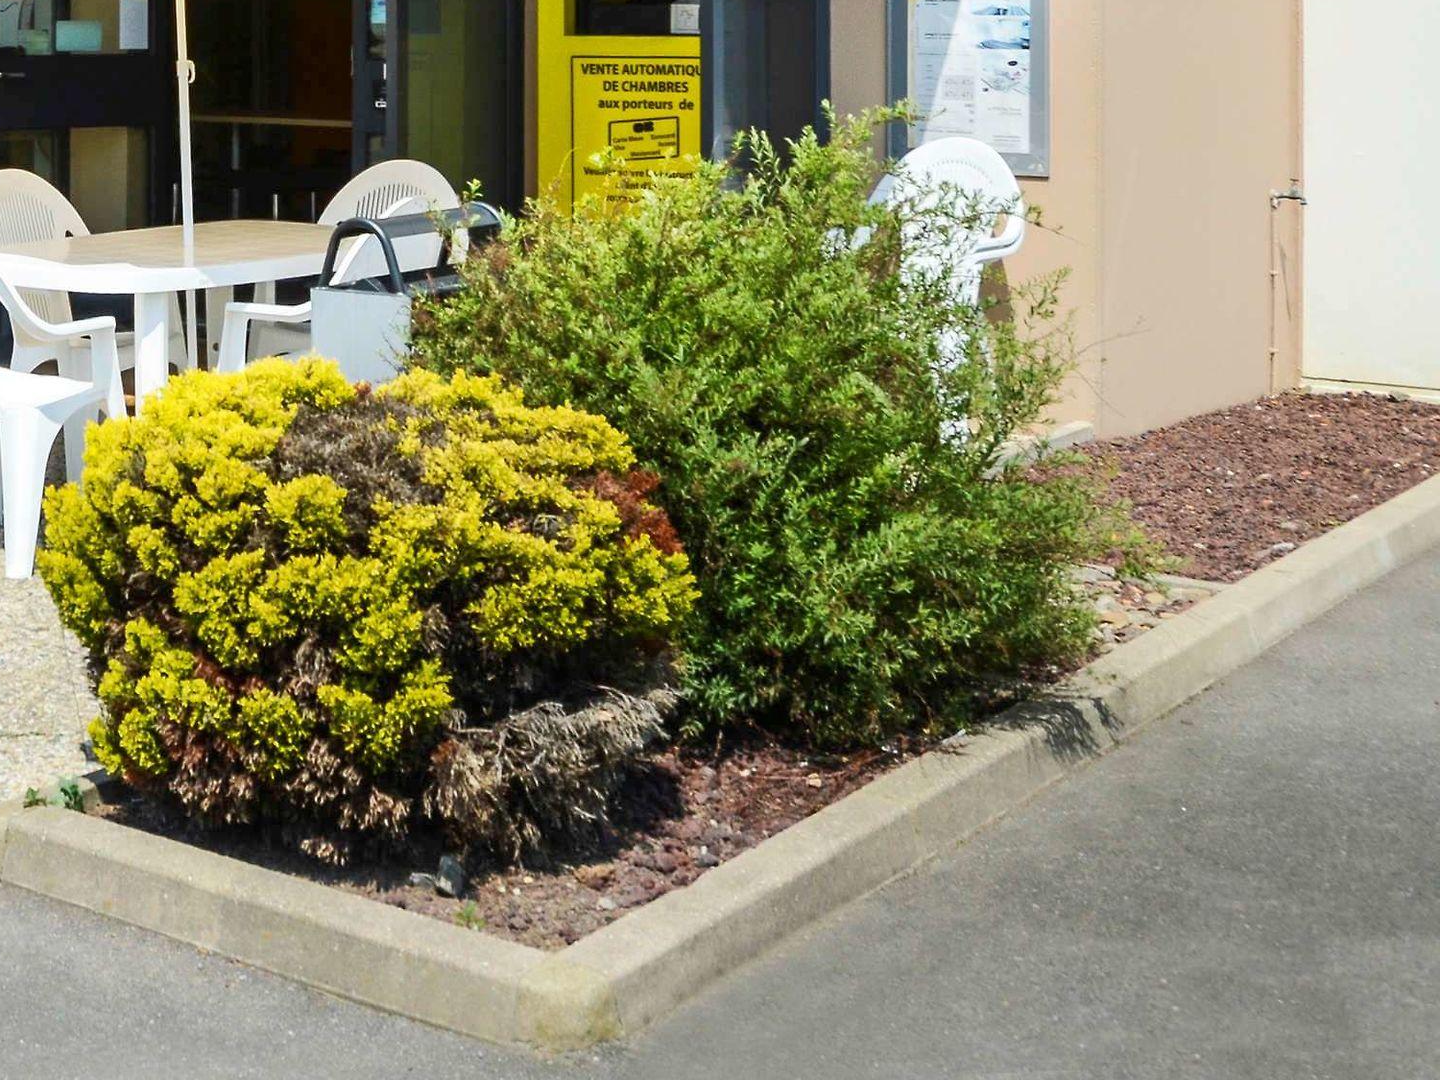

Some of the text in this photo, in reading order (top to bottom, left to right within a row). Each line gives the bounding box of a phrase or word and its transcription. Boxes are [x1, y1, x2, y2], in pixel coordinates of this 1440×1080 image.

[581, 63, 700, 76] VENTE AUTOMATIQU
[603, 81, 688, 93] DE CHAMBRES
[598, 99, 694, 111] aux porteurs de
